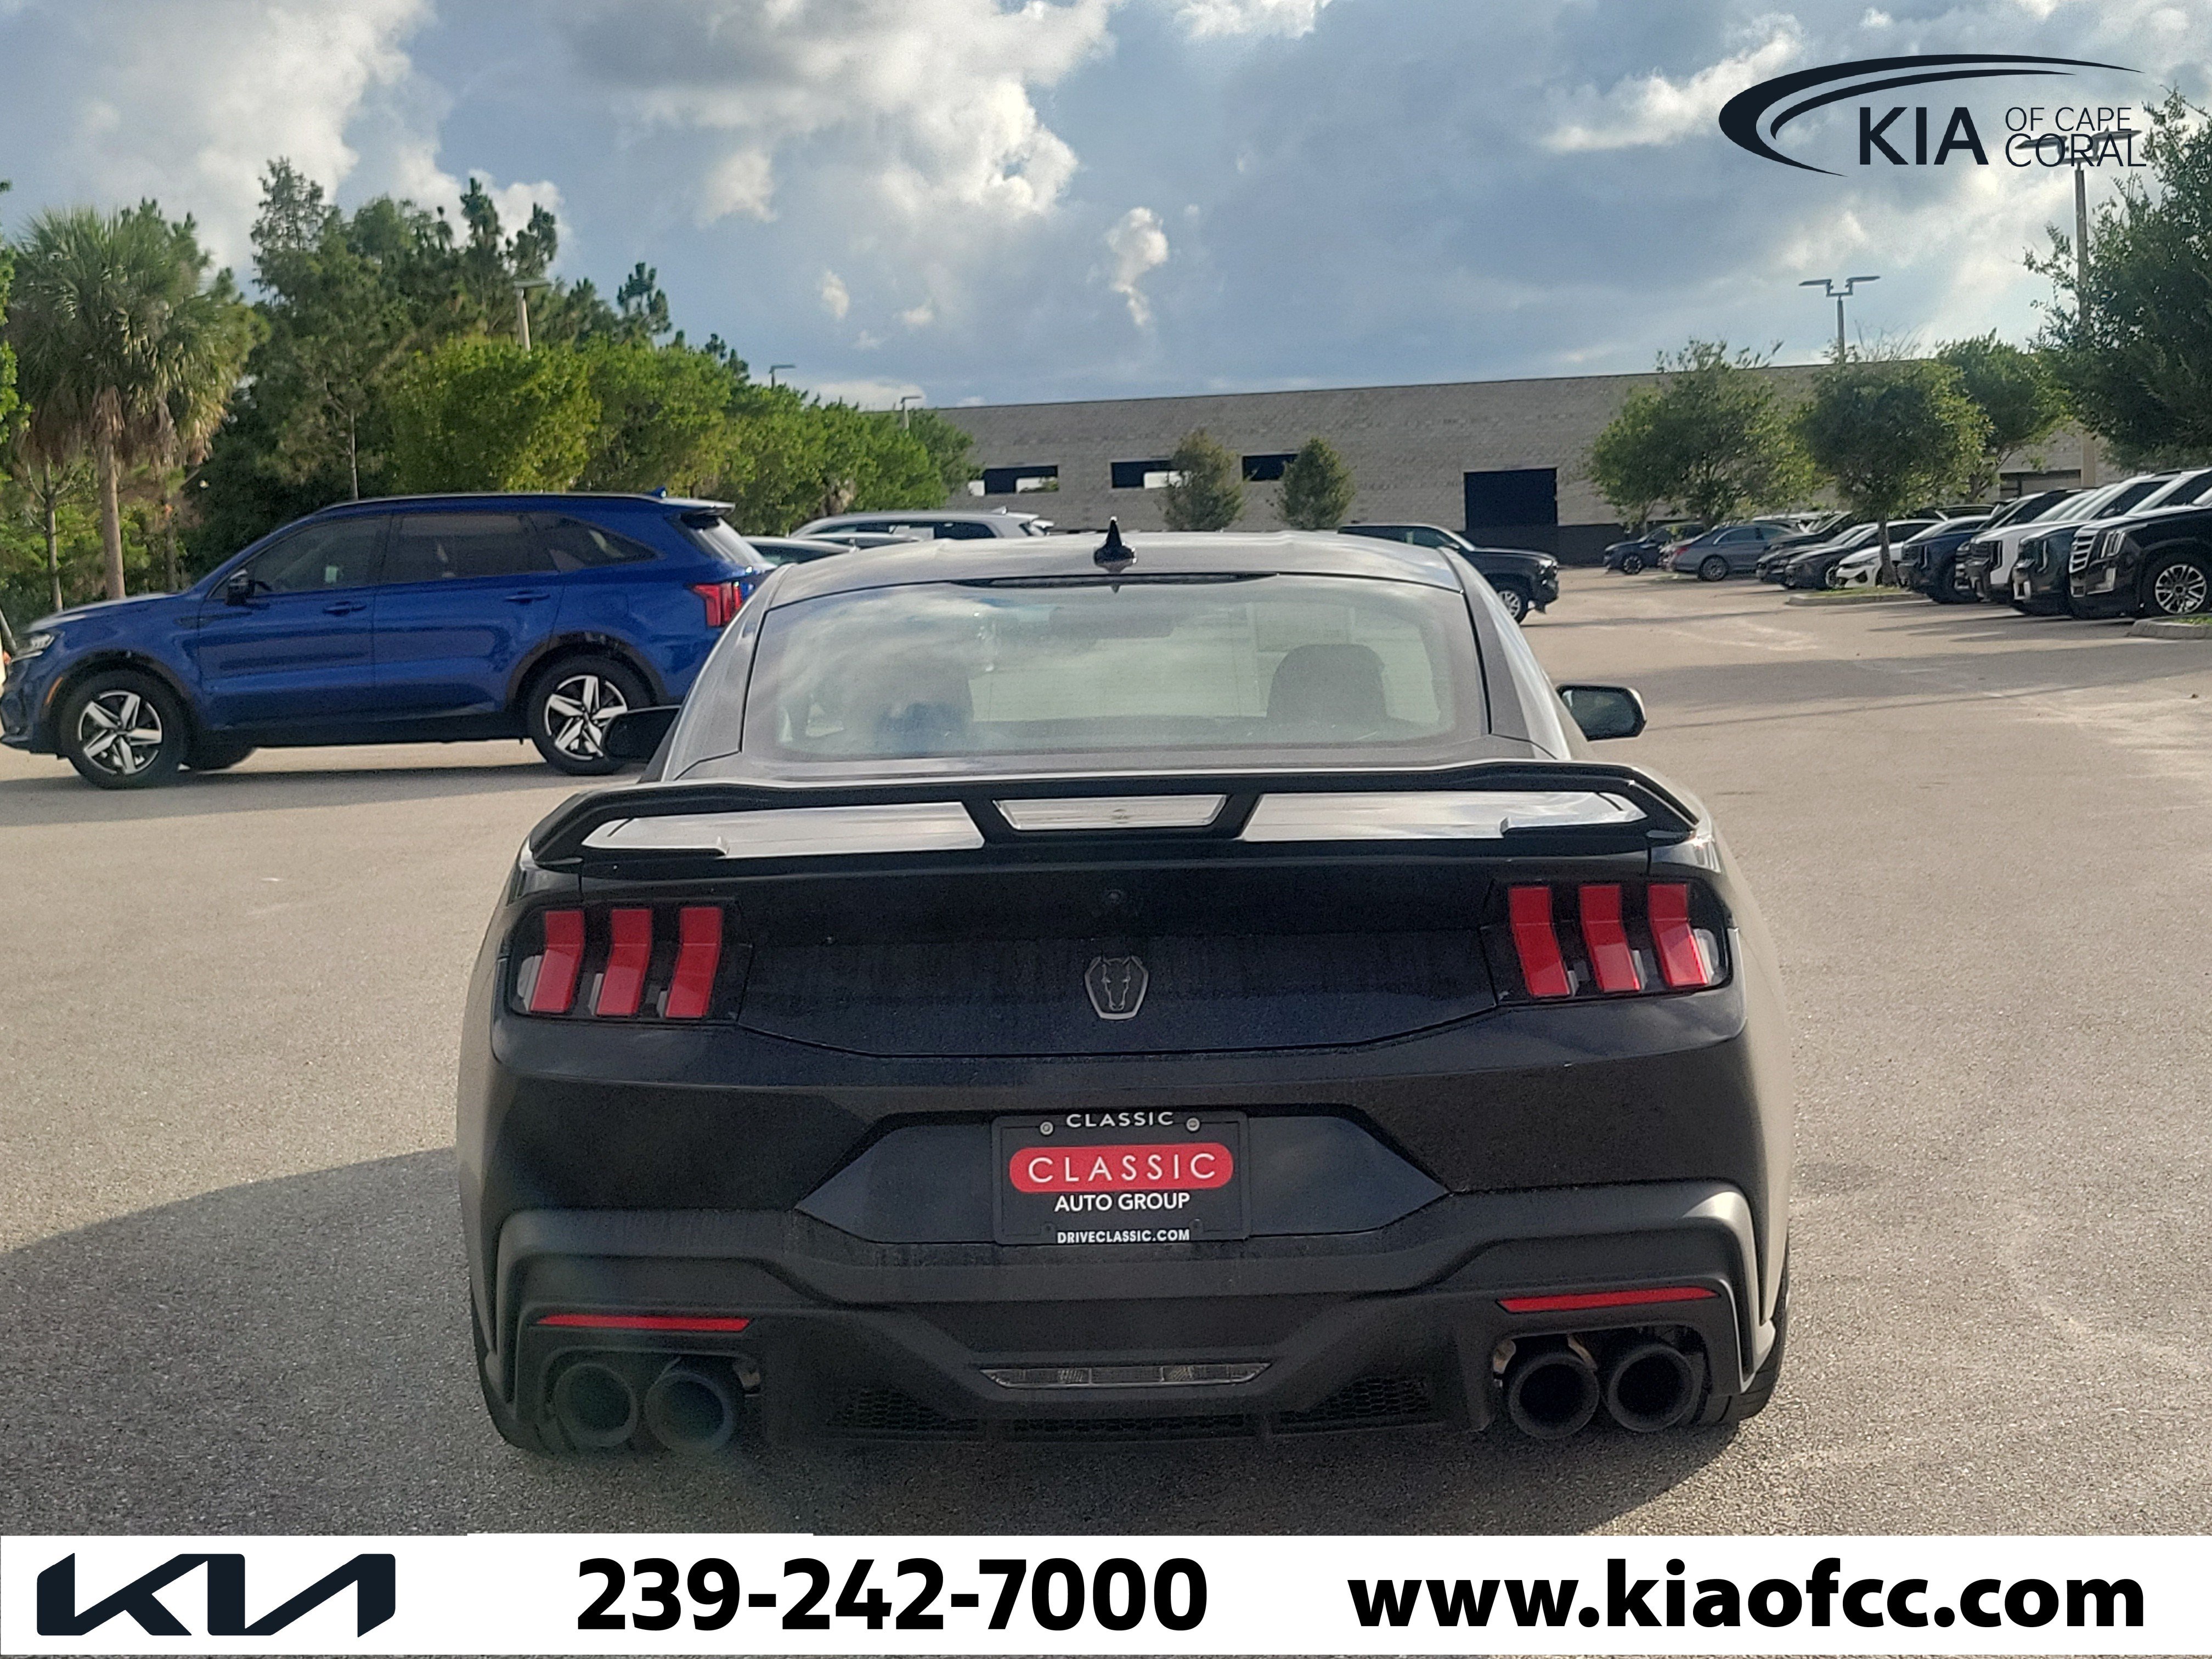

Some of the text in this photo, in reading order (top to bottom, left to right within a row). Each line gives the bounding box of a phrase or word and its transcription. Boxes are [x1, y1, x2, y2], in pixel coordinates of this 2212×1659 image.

[1066, 1111, 1174, 1128] CLASSIC
[1028, 1153, 1216, 1183] CLASSIC
[1054, 1192, 1190, 1212] AUTO GROUP
[1057, 1228, 1190, 1244] DRIVECLASSIC.COM
